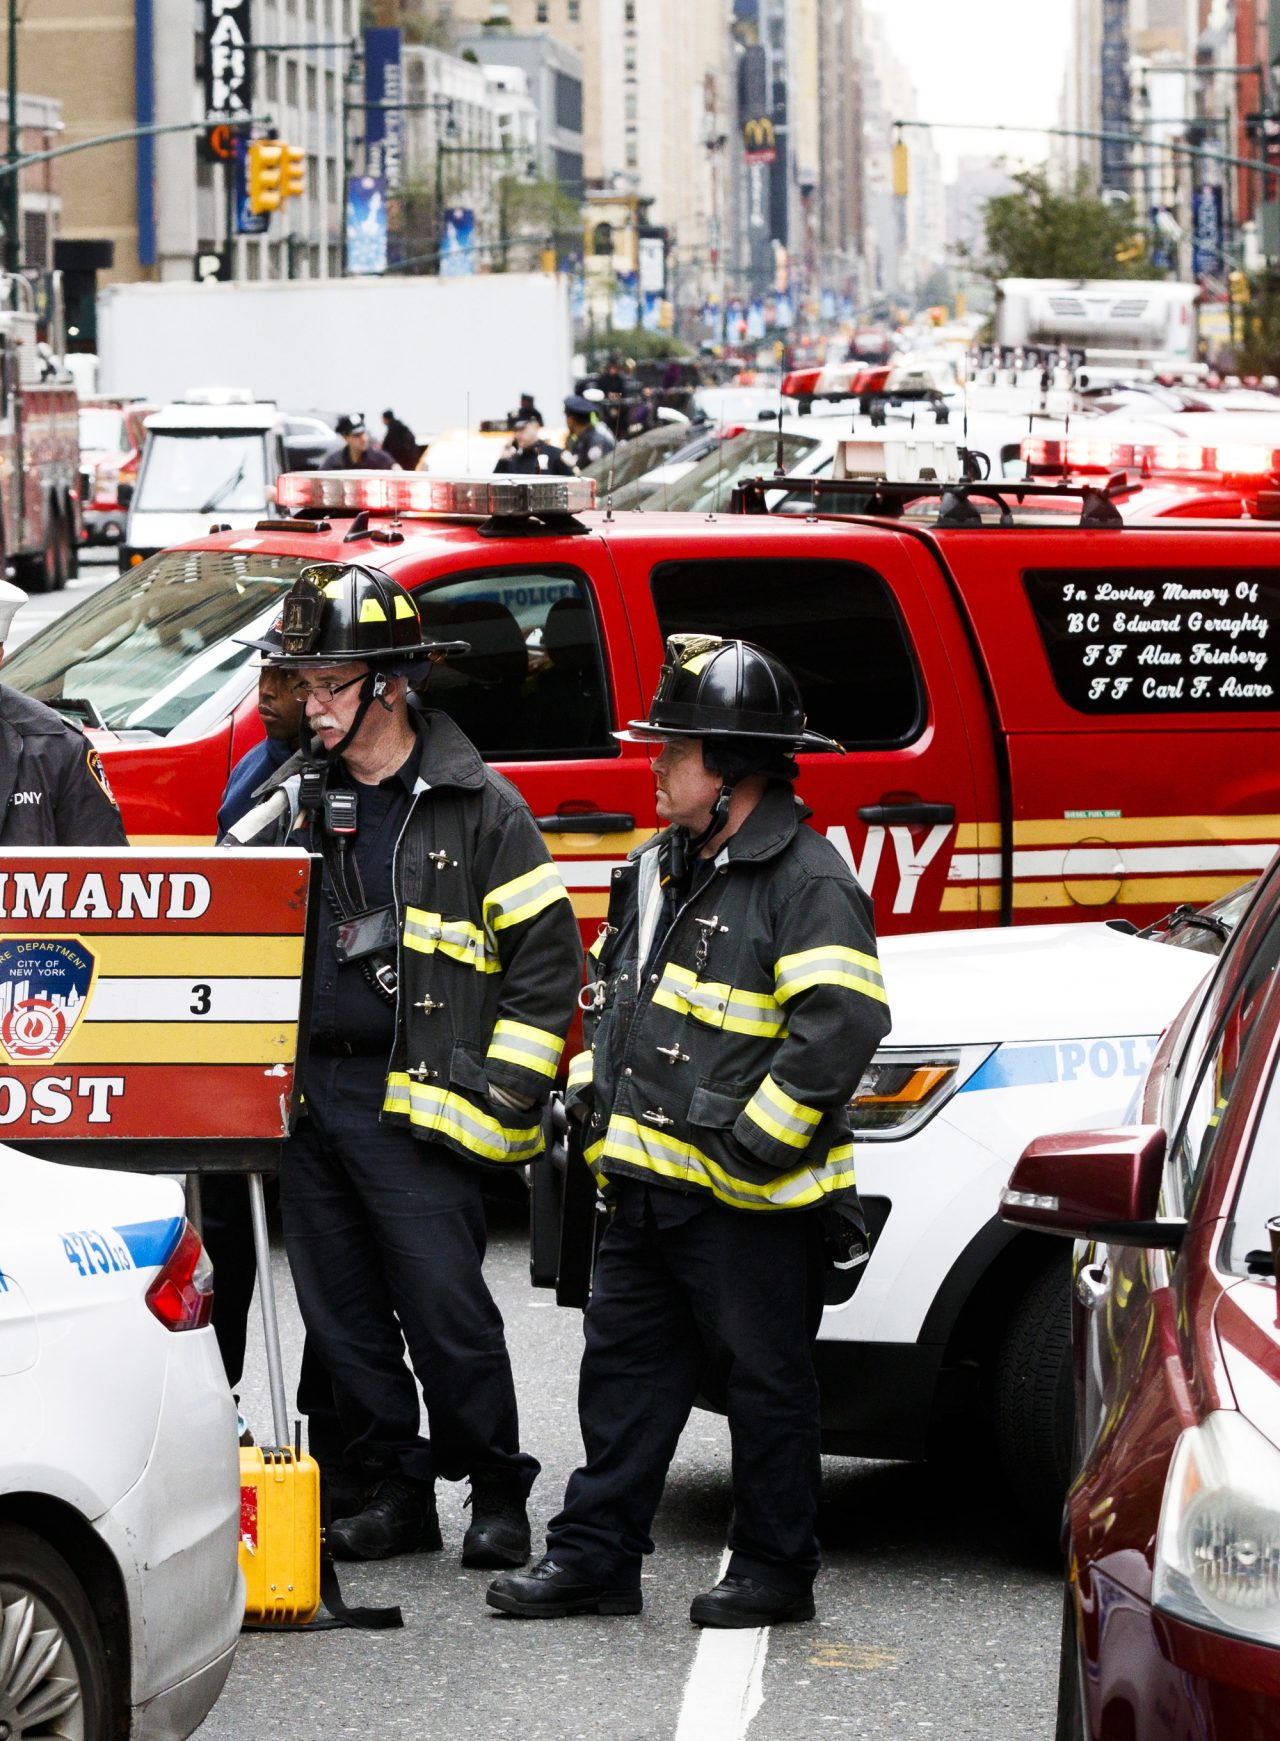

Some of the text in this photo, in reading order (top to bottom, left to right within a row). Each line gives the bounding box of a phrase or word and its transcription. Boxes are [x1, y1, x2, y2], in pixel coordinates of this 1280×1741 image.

[1063, 581, 1259, 607] In Loving Memory Of
[1113, 611, 1181, 632] Edward
[1188, 611, 1269, 639] Geraghty
[1137, 644, 1182, 665] Alan
[1189, 643, 1269, 672] Feinberg
[1142, 677, 1185, 699] Carl
[1190, 676, 1212, 699] F.
[1218, 676, 1274, 698] Asaro
[16, 942, 87, 971] DEPARTMENT
[17, 960, 59, 968] CITY OF
[9, 968, 66, 976] NEW YORK
[189, 984, 212, 1016] 3
